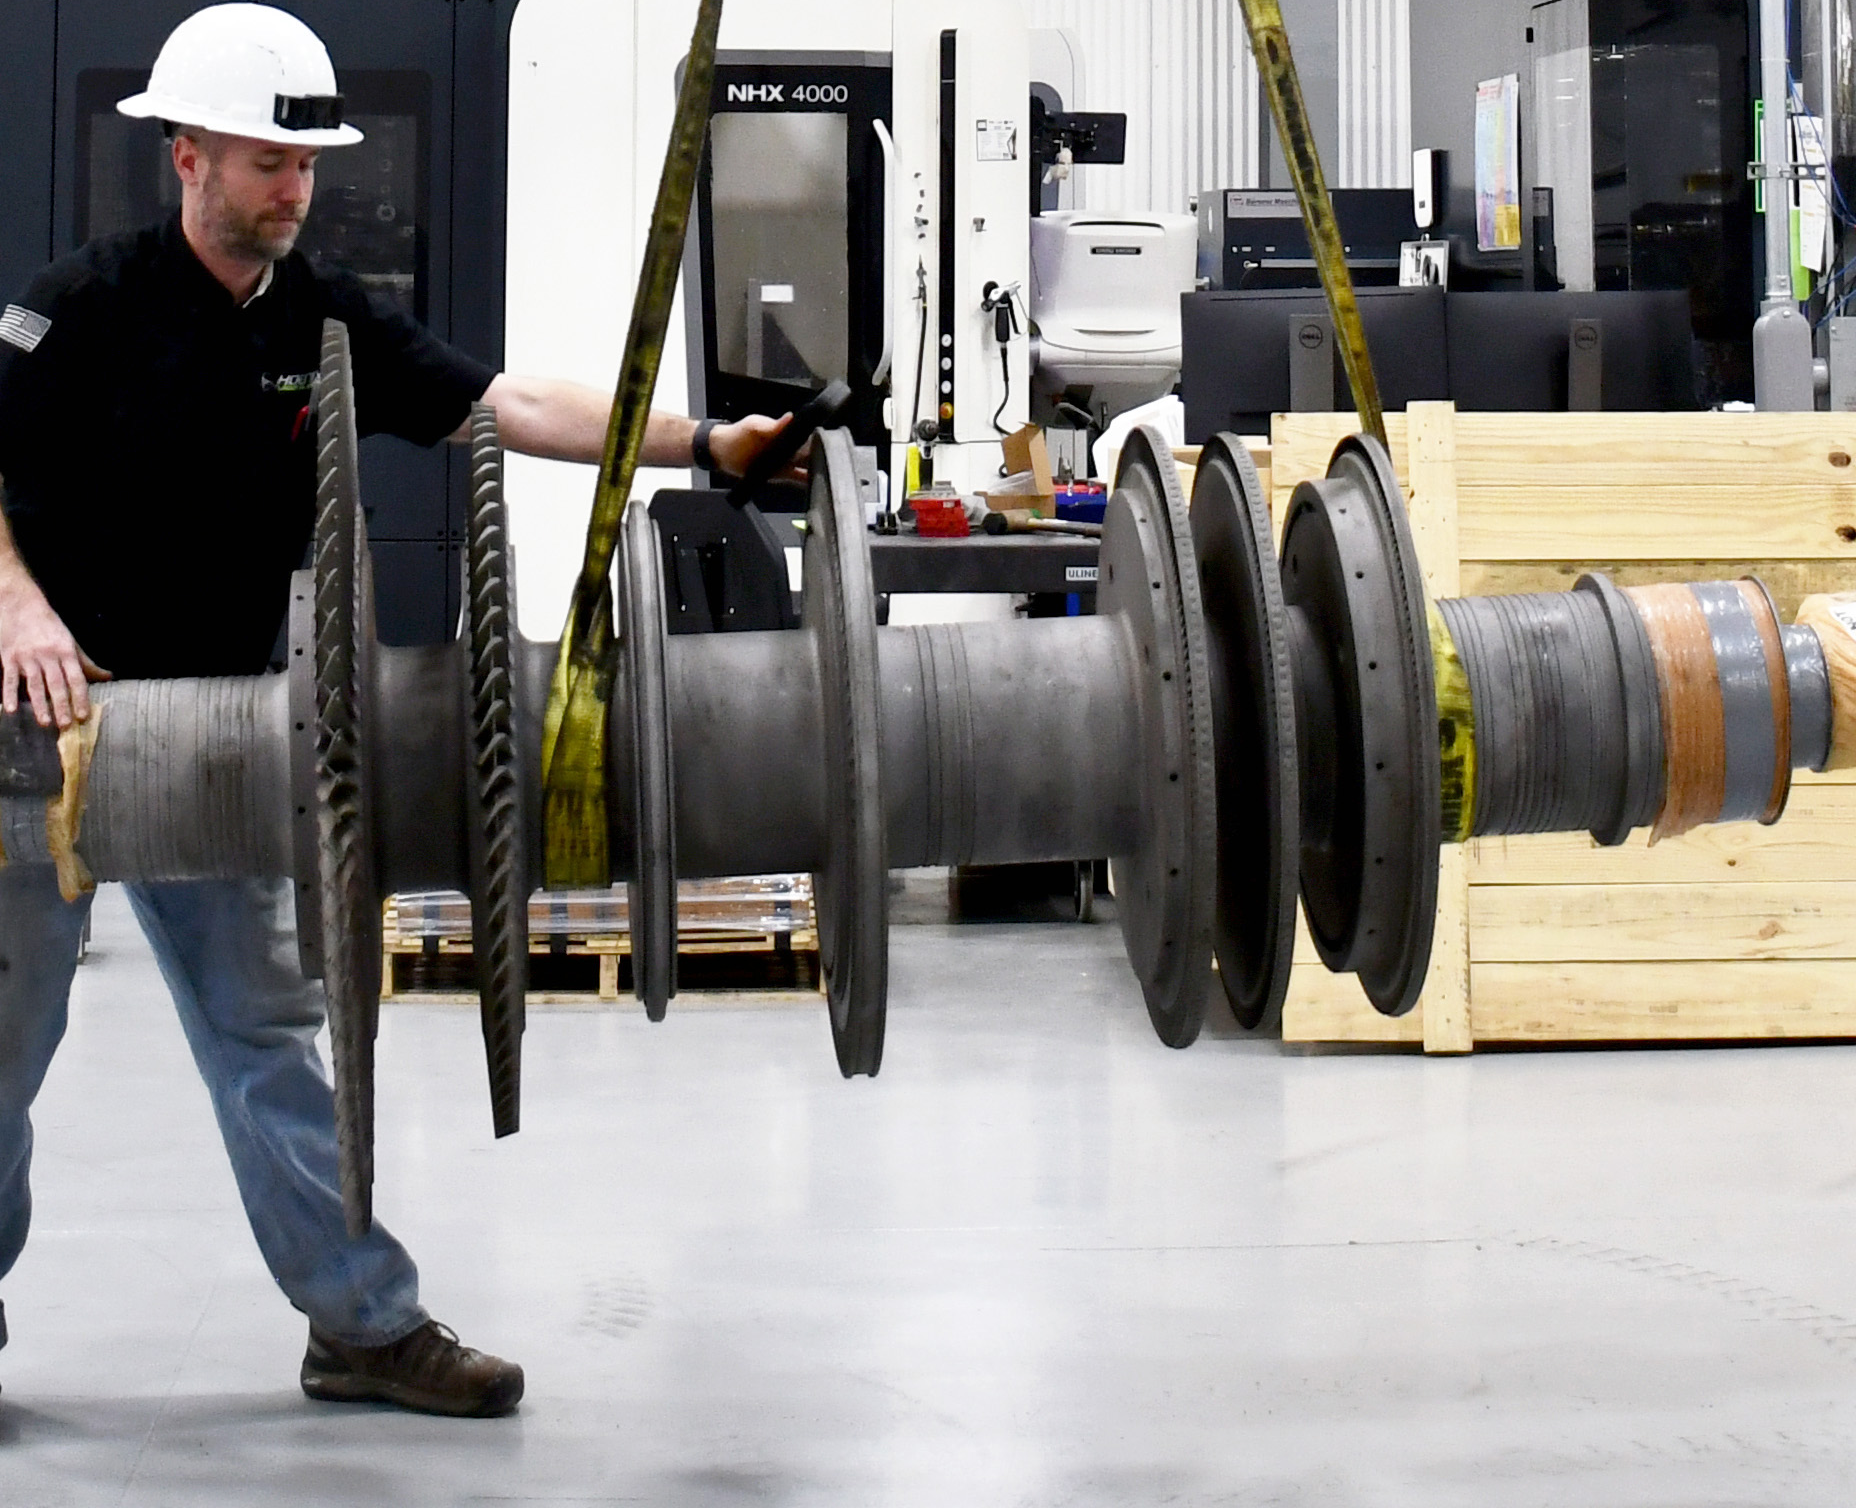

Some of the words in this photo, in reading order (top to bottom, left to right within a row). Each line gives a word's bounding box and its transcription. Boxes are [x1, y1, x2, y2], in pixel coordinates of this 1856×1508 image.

[727, 84, 785, 102] NHX
[791, 85, 848, 102] 4000
[1068, 569, 1099, 578] ULINE
